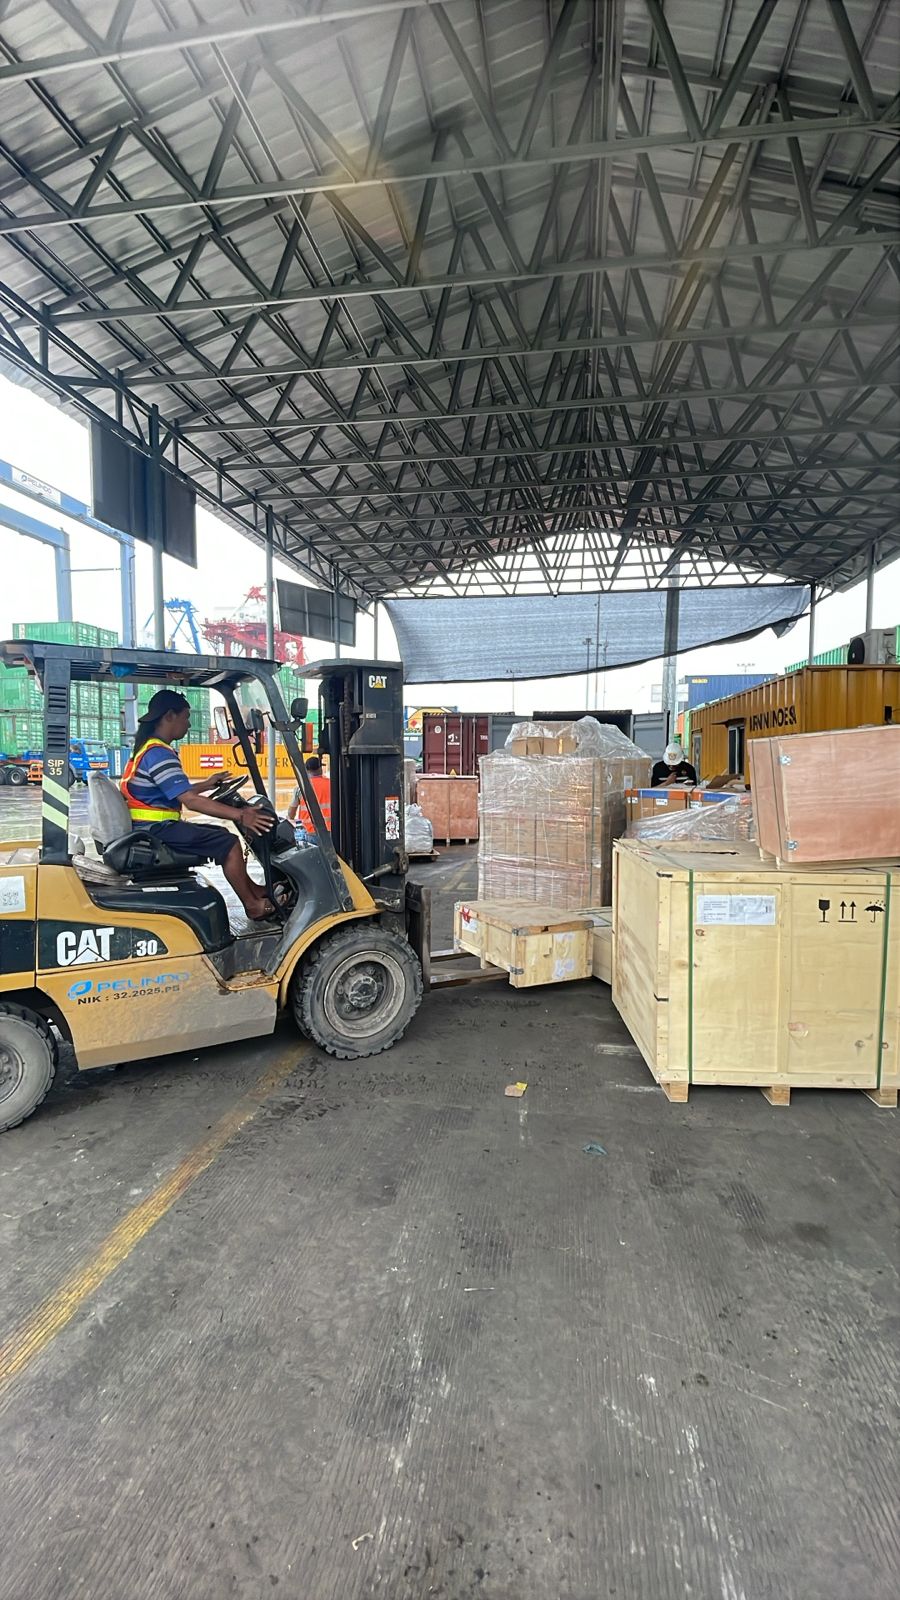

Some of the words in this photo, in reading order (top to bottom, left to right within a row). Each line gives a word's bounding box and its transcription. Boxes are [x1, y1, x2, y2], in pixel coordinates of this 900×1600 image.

[368, 675, 387, 688] CAT
[47, 759, 64, 767] SIP
[49, 767, 63, 776] 35
[56, 927, 114, 966] CAT
[136, 940, 158, 957] 30
[97, 972, 191, 993] PELINDO
[77, 996, 102, 1005] NIK
